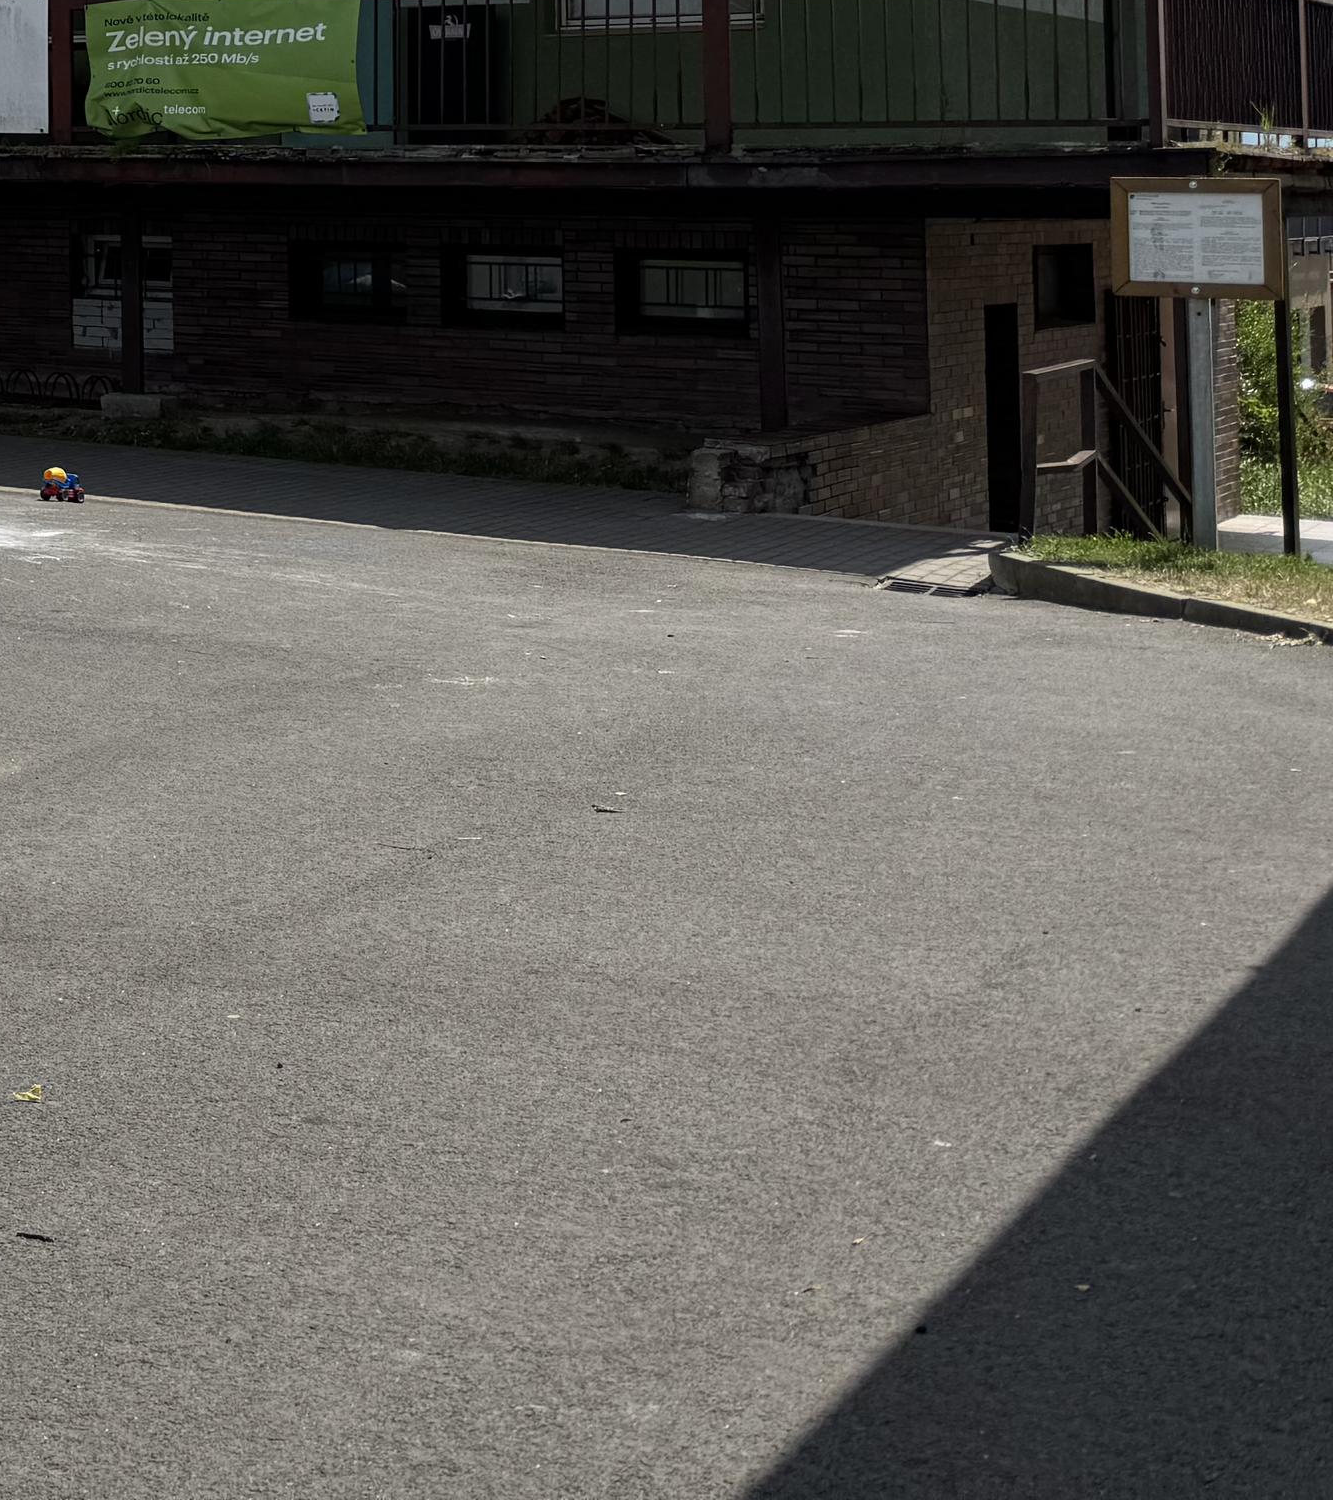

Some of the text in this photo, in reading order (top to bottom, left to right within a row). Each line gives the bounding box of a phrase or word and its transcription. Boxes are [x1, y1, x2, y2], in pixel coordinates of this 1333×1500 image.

[104, 15, 133, 27] Nově
[166, 12, 210, 23] lokalitě
[105, 22, 327, 52] Zelený internet
[107, 51, 260, 70] s rychlostí až 250 Mb/s
[164, 104, 206, 115] telecom
